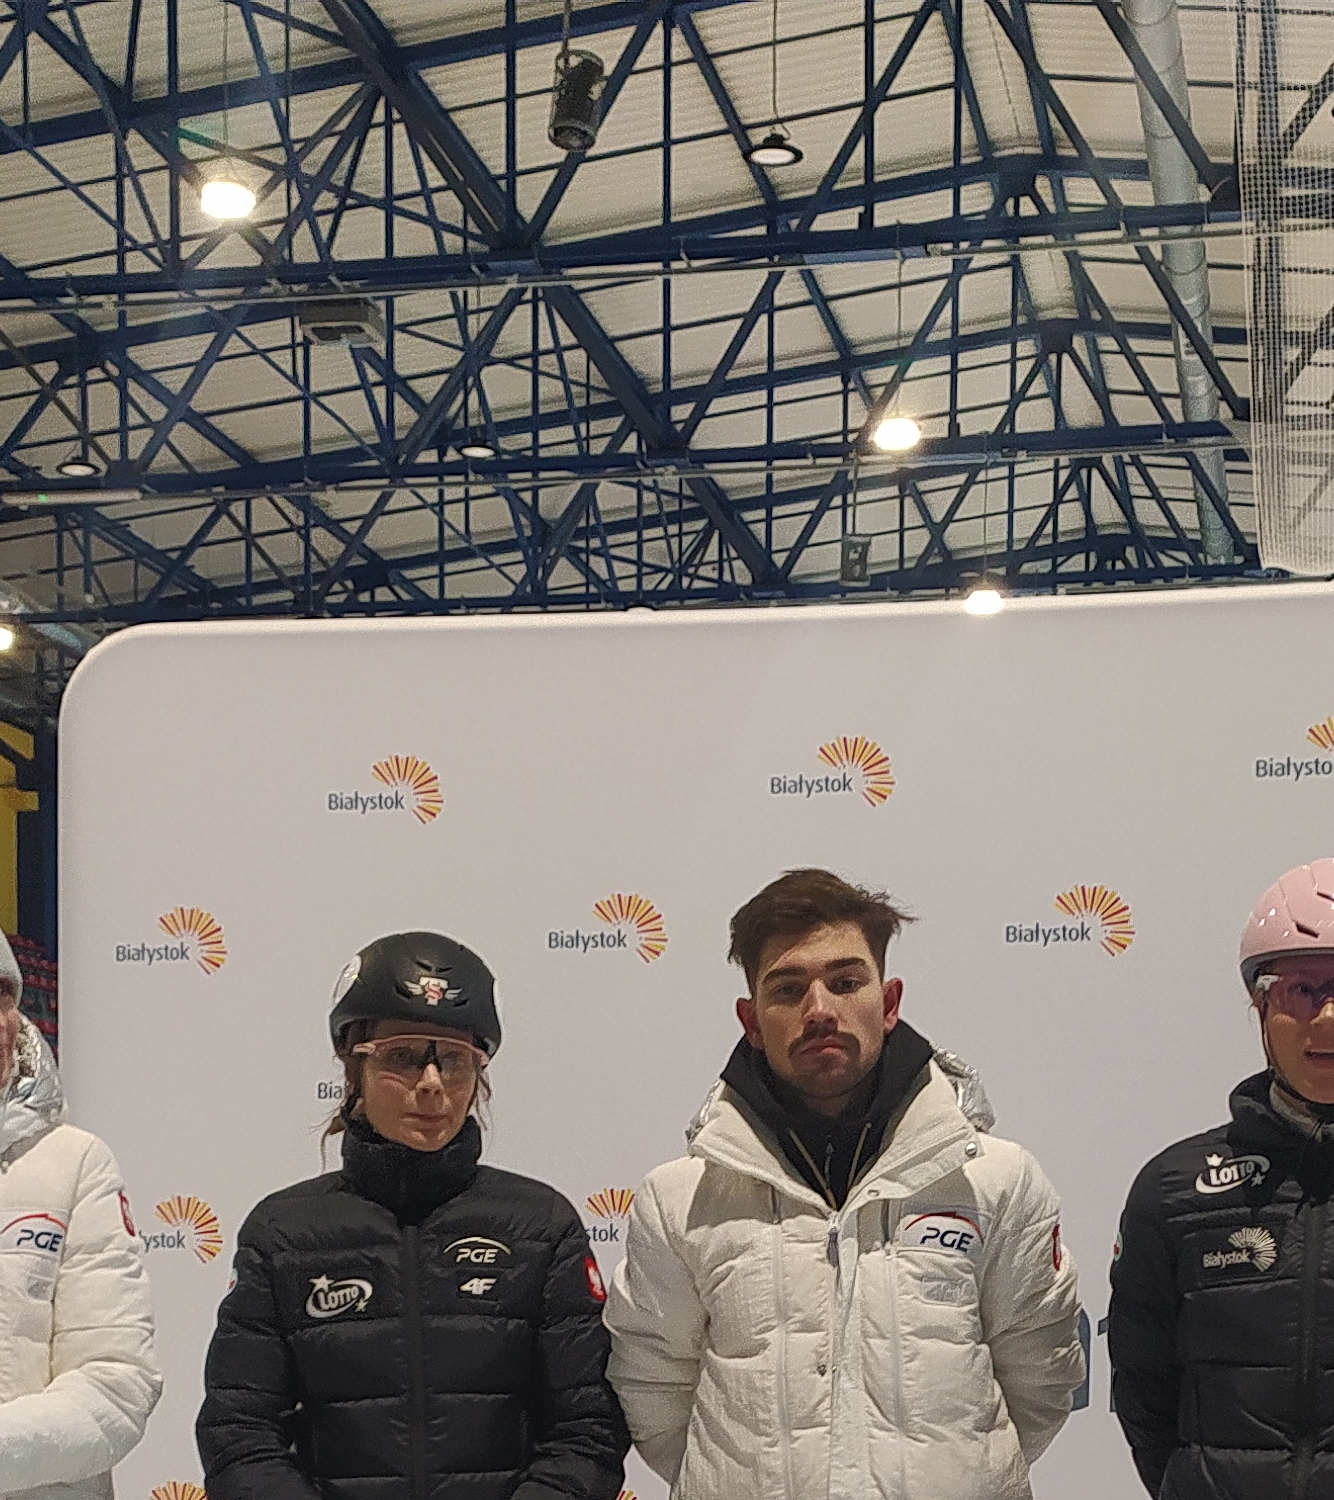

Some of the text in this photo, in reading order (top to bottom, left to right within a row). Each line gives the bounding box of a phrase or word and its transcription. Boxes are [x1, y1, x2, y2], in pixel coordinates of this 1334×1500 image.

[769, 772, 854, 799] Białystok
[327, 790, 405, 815] Białystok
[547, 927, 626, 954] Białystok
[1004, 921, 1091, 947] Białystok
[115, 941, 190, 967] Białystok
[1209, 1160, 1254, 1186] LOTTO
[16, 1228, 63, 1253] PGE
[919, 1226, 975, 1253] PGE
[455, 1247, 498, 1264] PGE
[317, 1284, 360, 1311] LOTTO
[460, 1276, 497, 1296] 4F
